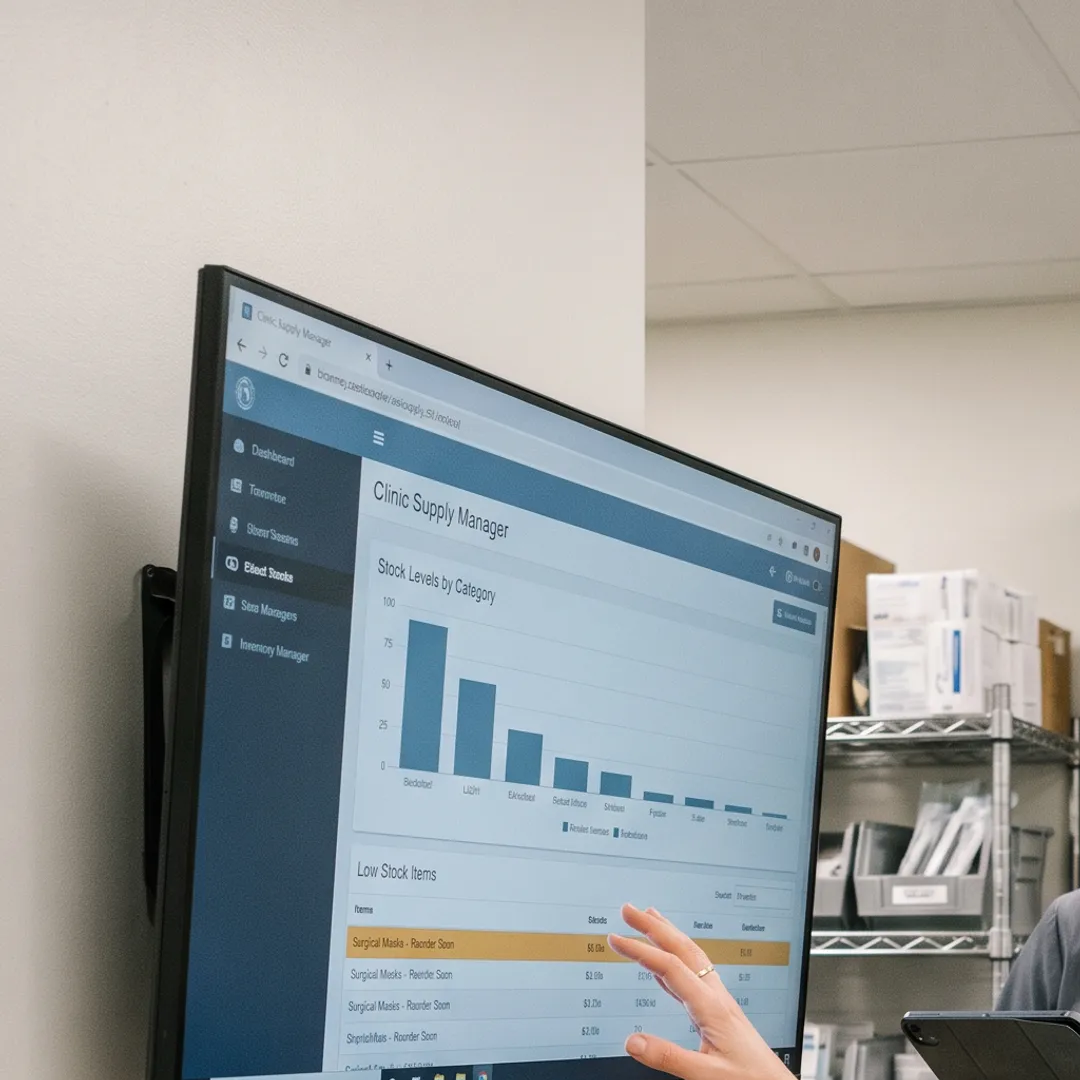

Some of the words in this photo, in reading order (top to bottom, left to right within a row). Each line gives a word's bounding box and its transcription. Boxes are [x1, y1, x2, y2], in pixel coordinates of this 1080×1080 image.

[374, 480, 410, 508] Clinic
[413, 493, 454, 527] Supply
[458, 506, 509, 540] Manager
[378, 558, 406, 579] Stock
[409, 566, 438, 588] Levels
[442, 575, 453, 595] by
[456, 578, 496, 606] Category
[383, 597, 396, 608] 100
[384, 638, 393, 648] 75
[276, 645, 310, 663] Manager
[382, 679, 390, 689] 50
[379, 720, 388, 730] 25
[357, 862, 378, 878] Low
[381, 863, 408, 880] Stock
[412, 865, 436, 881] Items
[353, 937, 380, 950] Surgical
[351, 969, 378, 982] Surgical
[348, 1001, 376, 1014] Surgical
[434, 1000, 450, 1010] Soon
[421, 1031, 437, 1041] Soon
